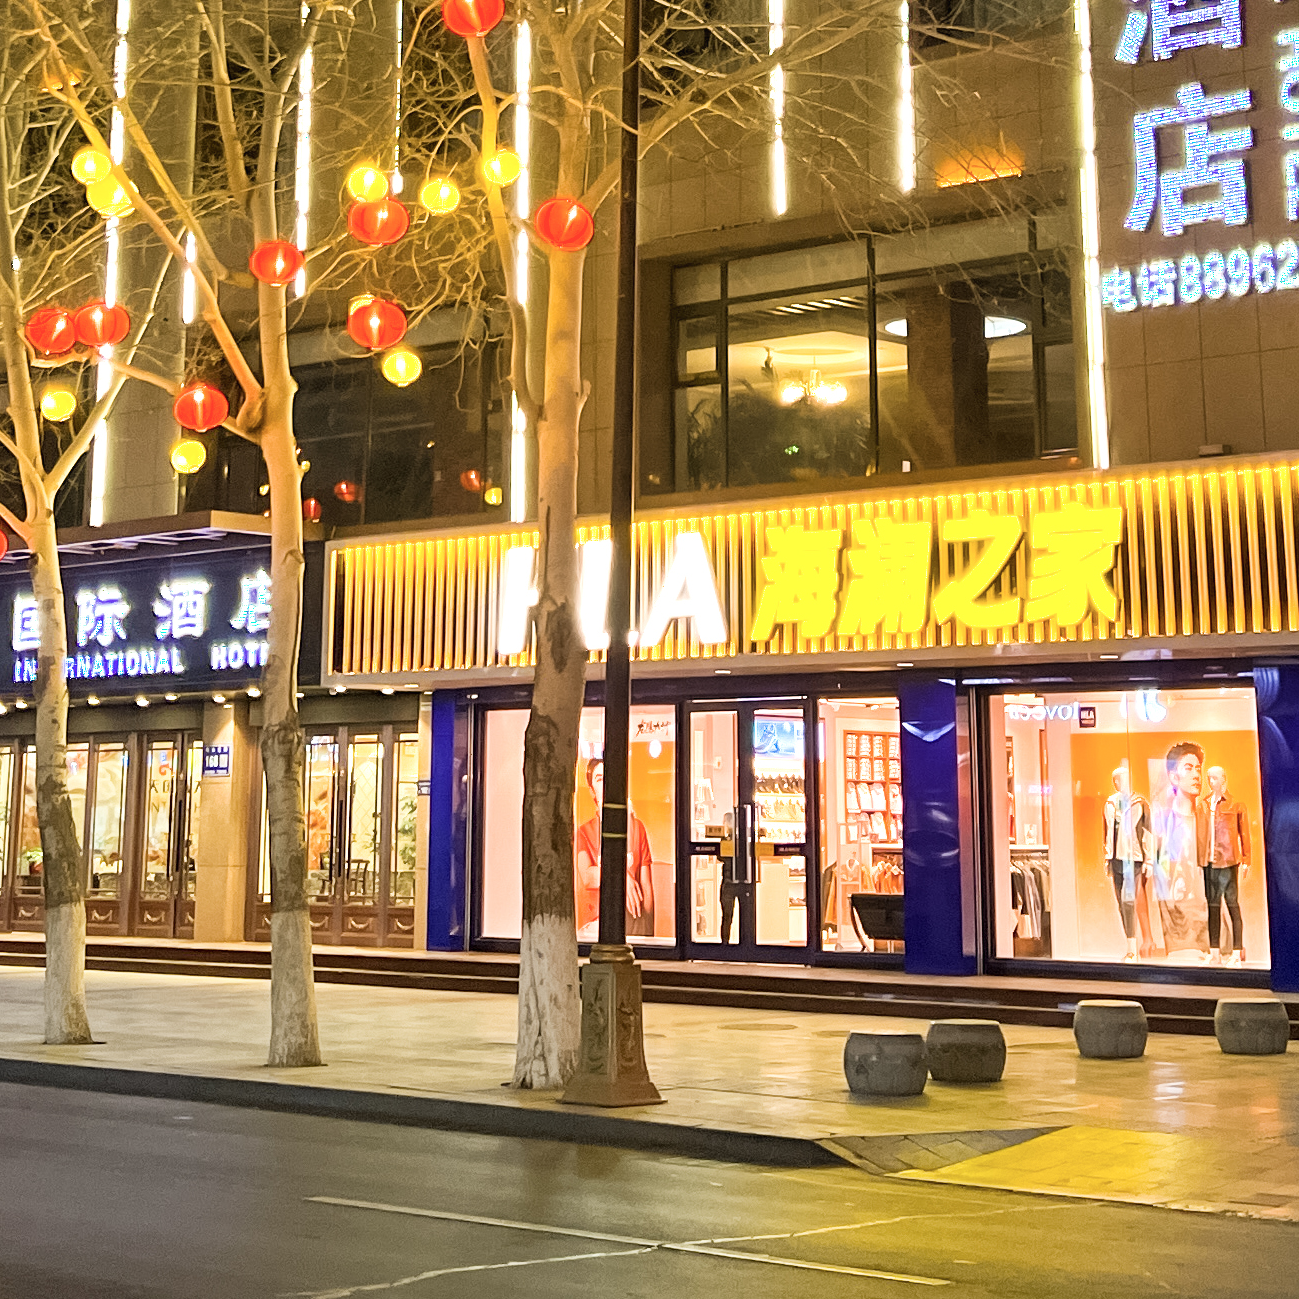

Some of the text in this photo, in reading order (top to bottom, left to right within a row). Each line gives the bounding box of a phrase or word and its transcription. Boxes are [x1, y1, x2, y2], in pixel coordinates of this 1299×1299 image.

[751, 503, 1122, 642] 海澜之家
[13, 645, 185, 683] INRNATIONAL
